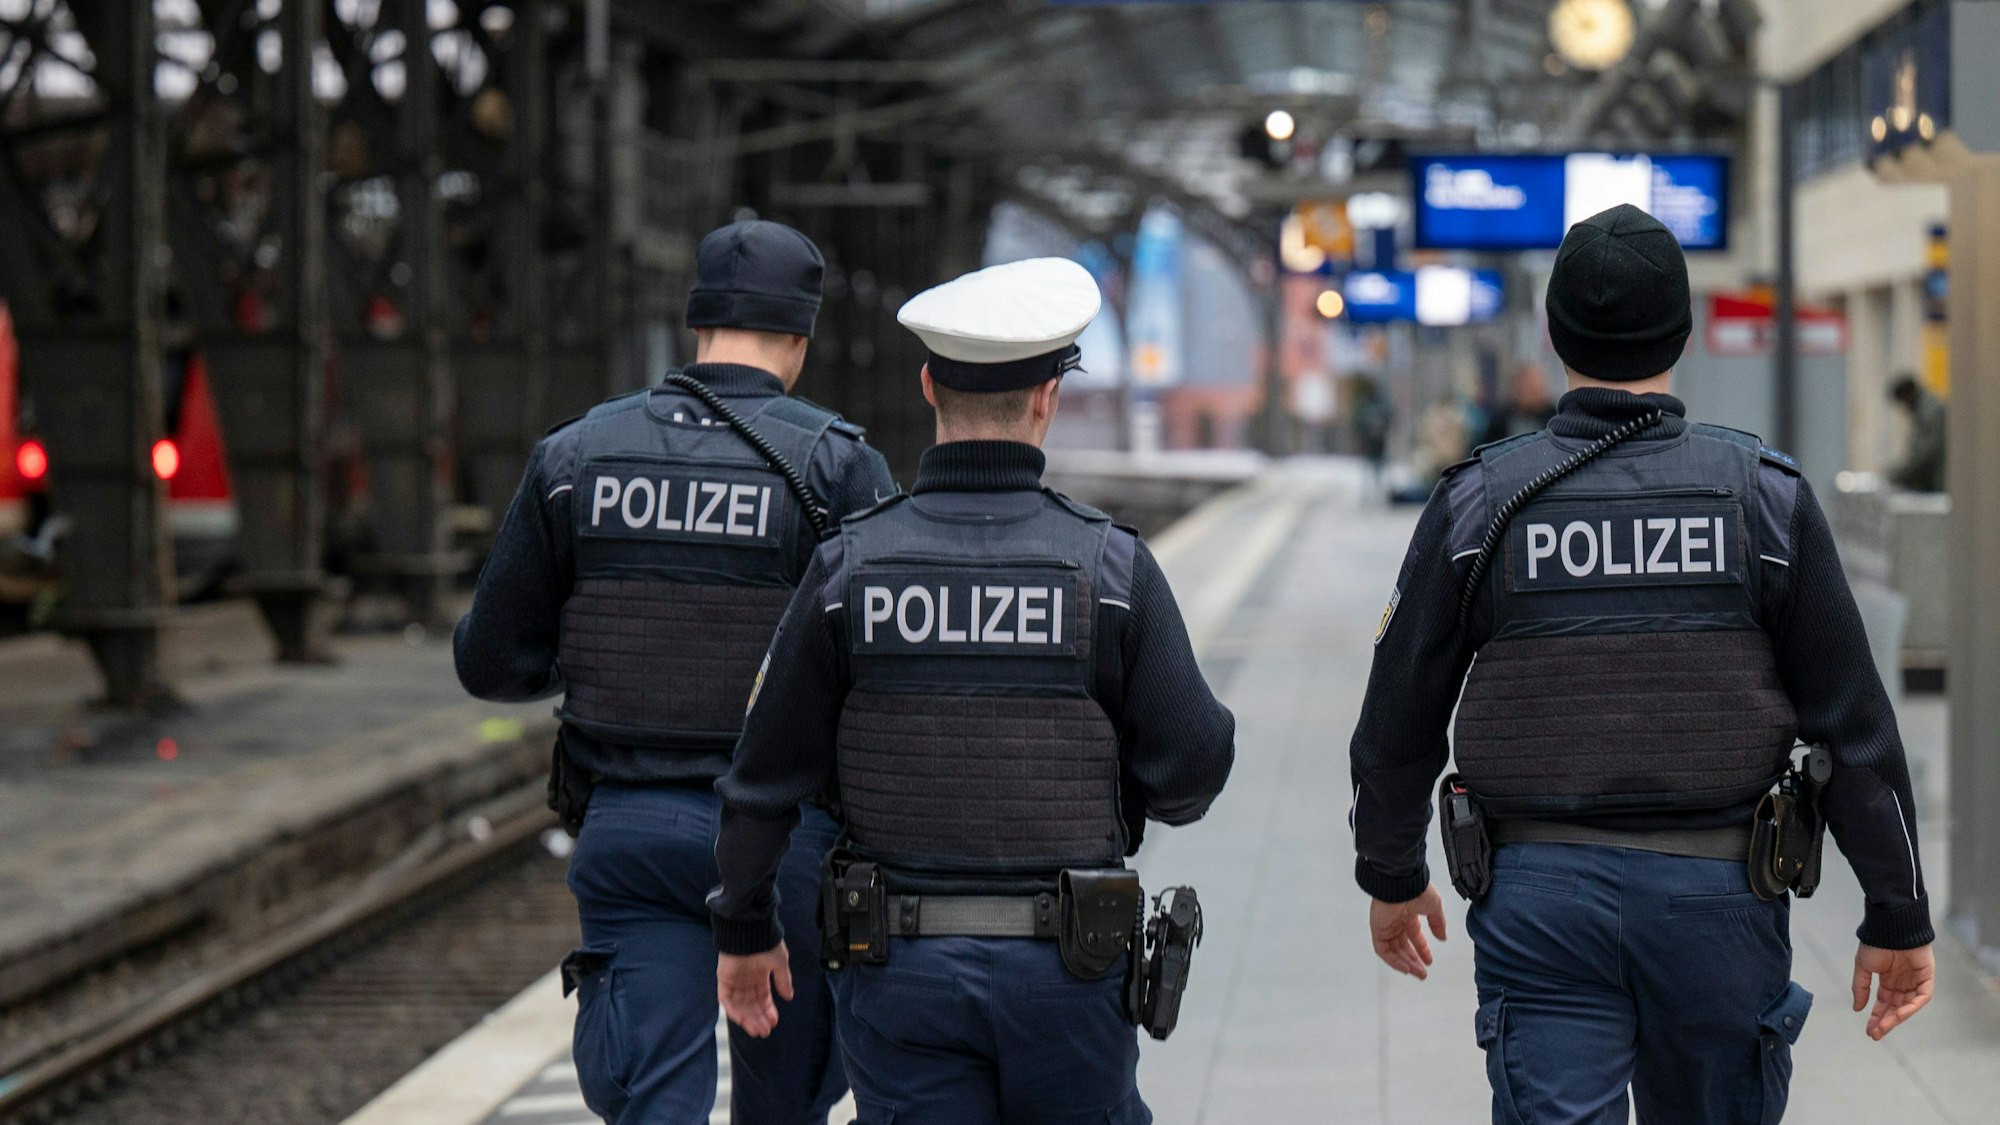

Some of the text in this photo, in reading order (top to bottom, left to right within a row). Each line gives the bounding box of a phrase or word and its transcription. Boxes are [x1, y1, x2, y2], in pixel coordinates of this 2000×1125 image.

[591, 476, 772, 537] POLIZEI
[1526, 516, 1726, 580] POLIZEI
[864, 585, 1063, 644] POLIZEI
